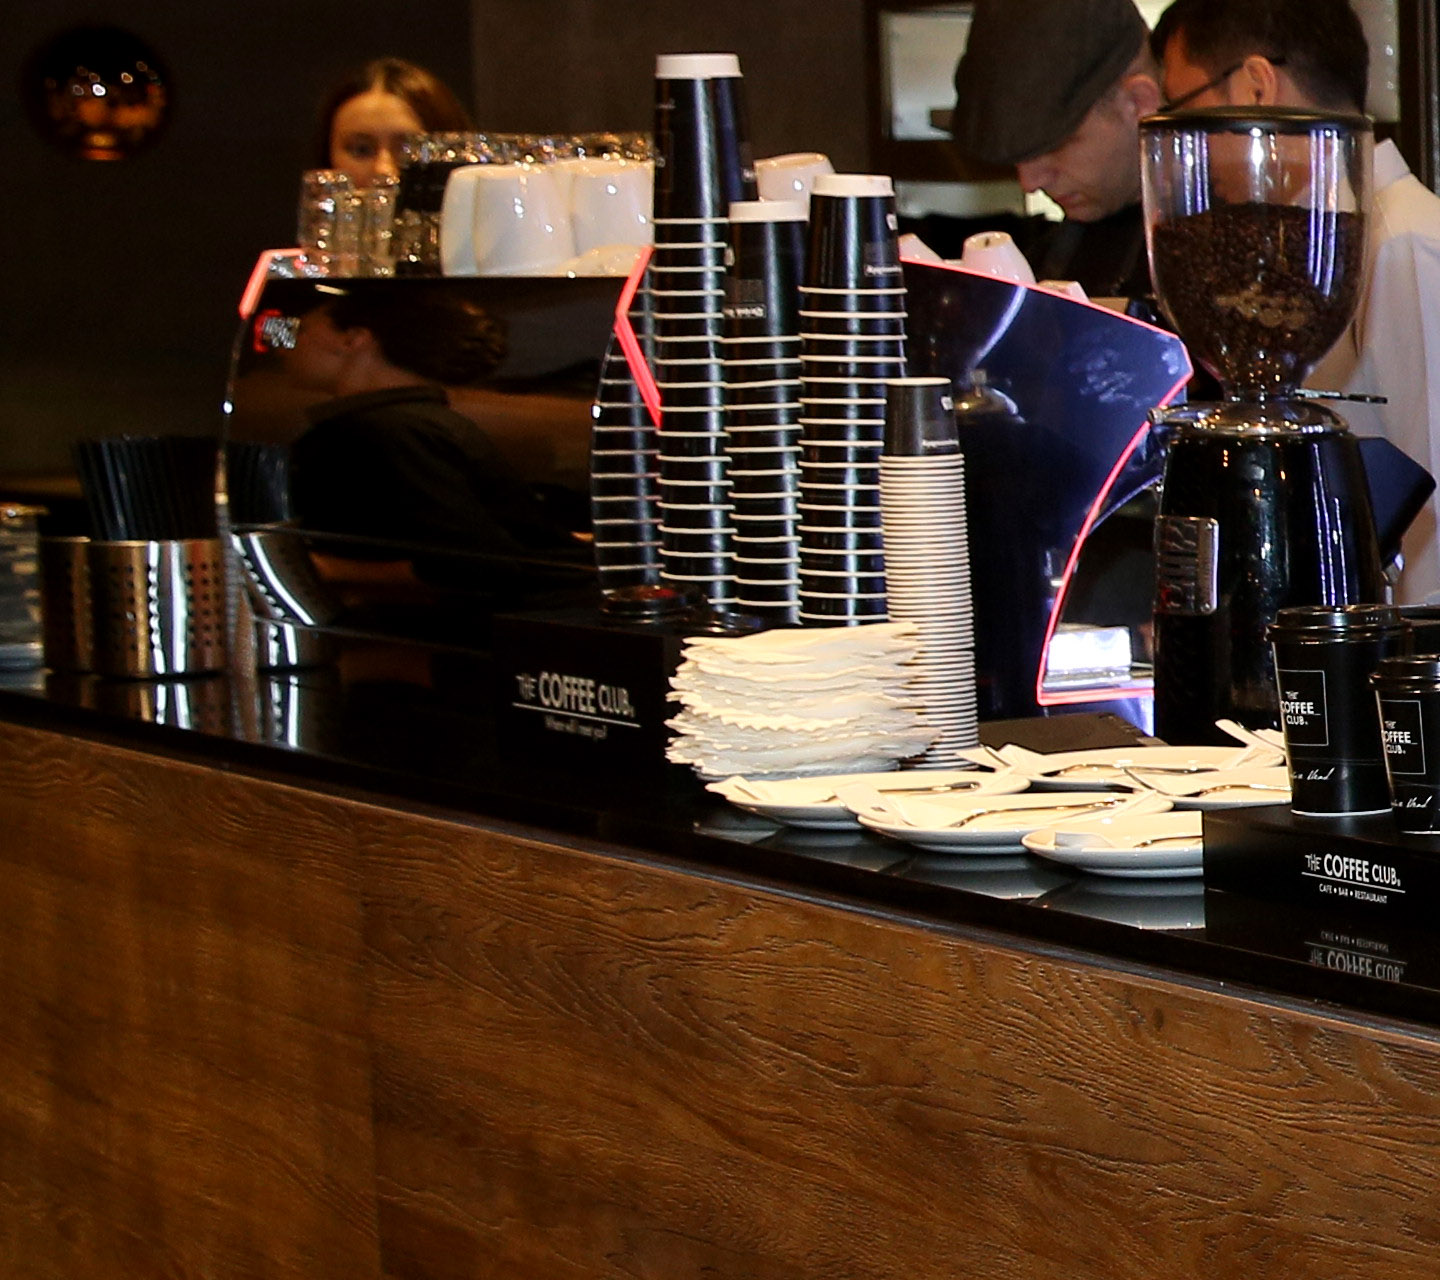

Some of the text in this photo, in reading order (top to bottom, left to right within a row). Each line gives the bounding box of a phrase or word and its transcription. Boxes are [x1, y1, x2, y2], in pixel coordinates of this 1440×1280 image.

[540, 671, 597, 714] COFFEE
[1304, 852, 1397, 886] THE COFFEE CLUB
